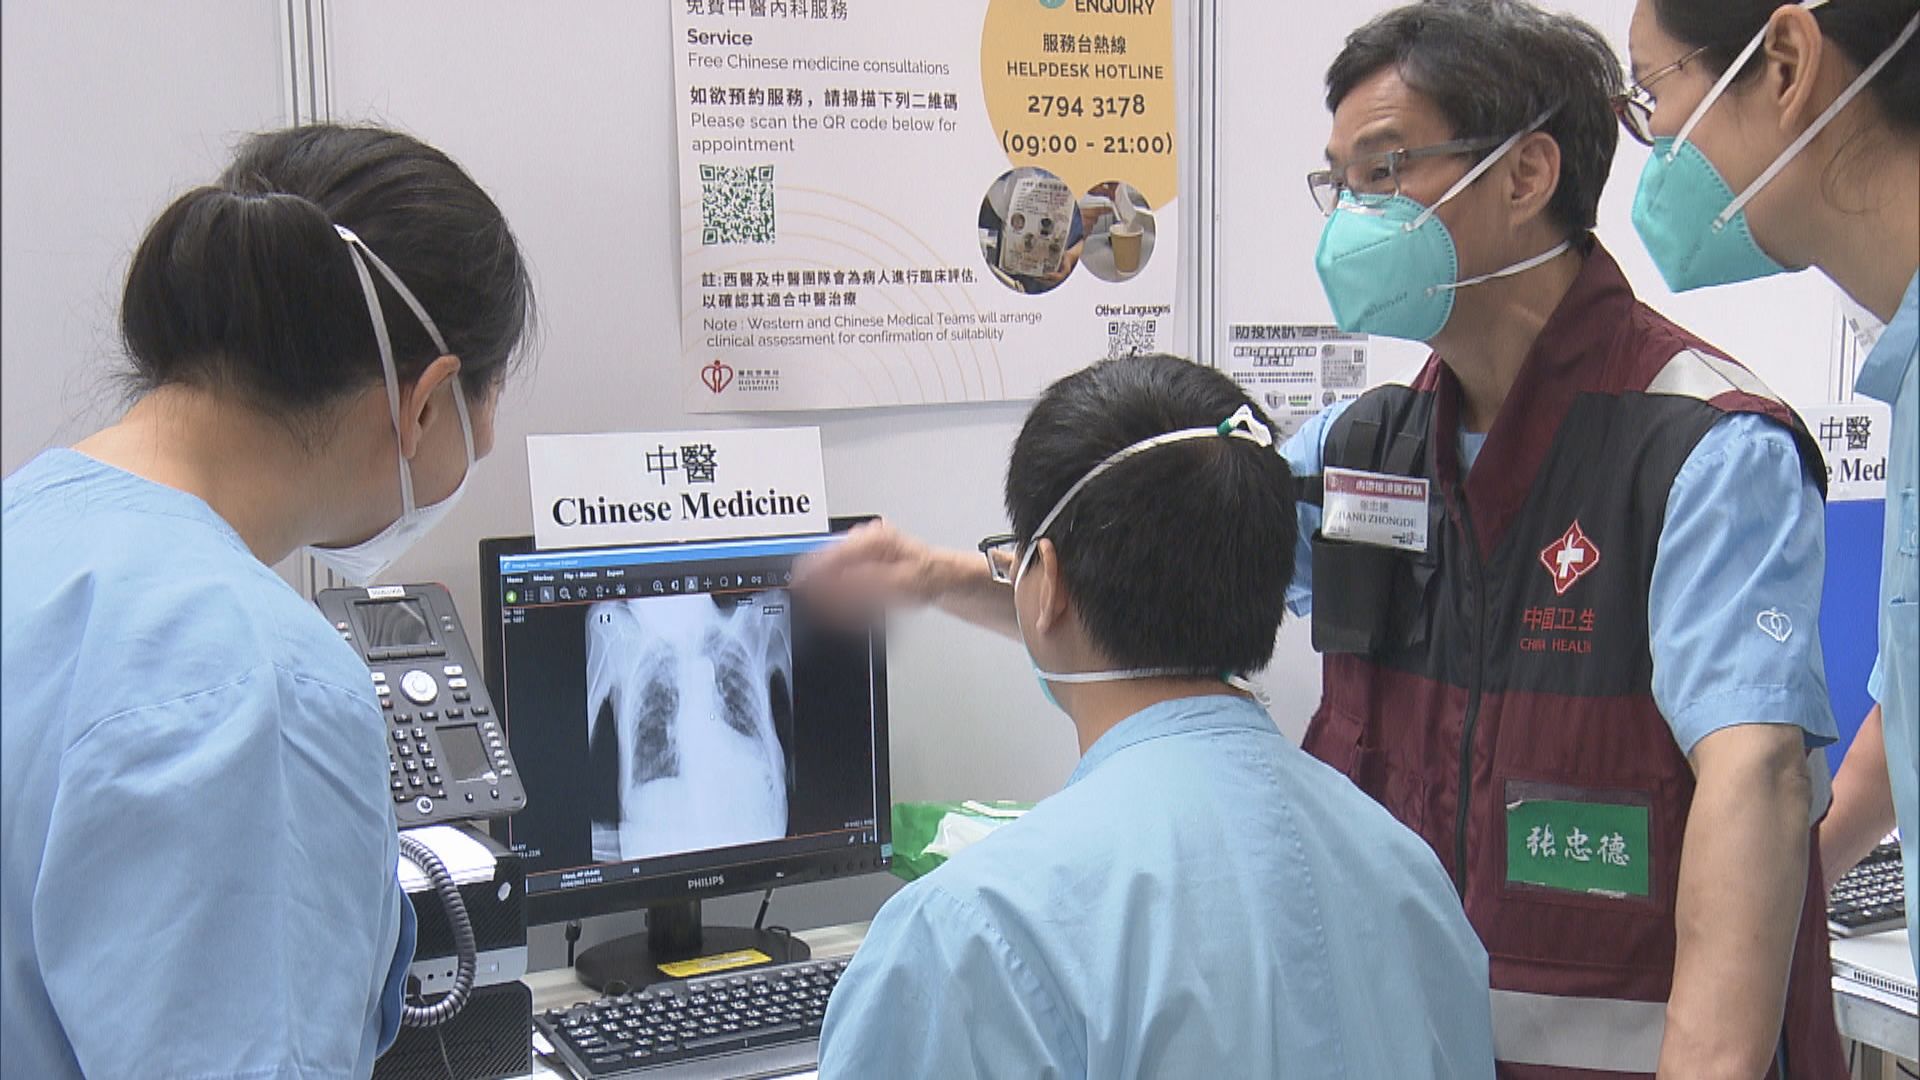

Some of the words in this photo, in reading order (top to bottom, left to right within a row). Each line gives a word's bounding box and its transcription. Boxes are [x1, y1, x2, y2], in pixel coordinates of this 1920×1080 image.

[1075, 0, 1155, 15] ENQUIRY
[687, 28, 753, 46] Service
[1043, 33, 1126, 55] 服務台熱線
[688, 52, 723, 68] Free
[727, 54, 789, 70] Chinese
[793, 56, 860, 72] medicine
[863, 58, 950, 76] consultations
[1007, 61, 1090, 79] HELPDESK
[1095, 64, 1164, 80] HOTLINE
[1028, 95, 1084, 118] 2794
[1092, 94, 1146, 118] 3178
[691, 112, 745, 129] Please
[750, 116, 788, 130] scan
[792, 115, 818, 130] the
[823, 114, 846, 130] QR
[850, 116, 888, 131] code
[892, 116, 935, 132] below
[938, 116, 957, 132] for
[692, 136, 795, 155] appointment
[1002, 130, 1077, 157] (09:00
[1103, 132, 1173, 155] 21:00)
[704, 317, 737, 331] Note
[747, 317, 804, 330] Western
[807, 315, 831, 329] and
[834, 314, 884, 328] Chinese
[887, 312, 934, 326] Medical
[937, 311, 975, 325] Teams
[979, 310, 998, 323] will
[1000, 311, 1042, 324] arrange
[1095, 304, 1121, 316] Other
[1123, 304, 1171, 317] Languages
[706, 333, 754, 347] clinical
[758, 332, 836, 347] assessment
[838, 330, 855, 344] for
[859, 329, 933, 344] confirmation
[936, 328, 949, 341] of
[952, 326, 1005, 342] suitability
[1820, 415, 1872, 452] 中醫
[645, 443, 718, 486] 中醫
[552, 496, 672, 528] Chinese
[681, 489, 811, 521] Medicine
[1522, 606, 1596, 632] 中国卫生
[687, 874, 725, 890] PHILIPS
